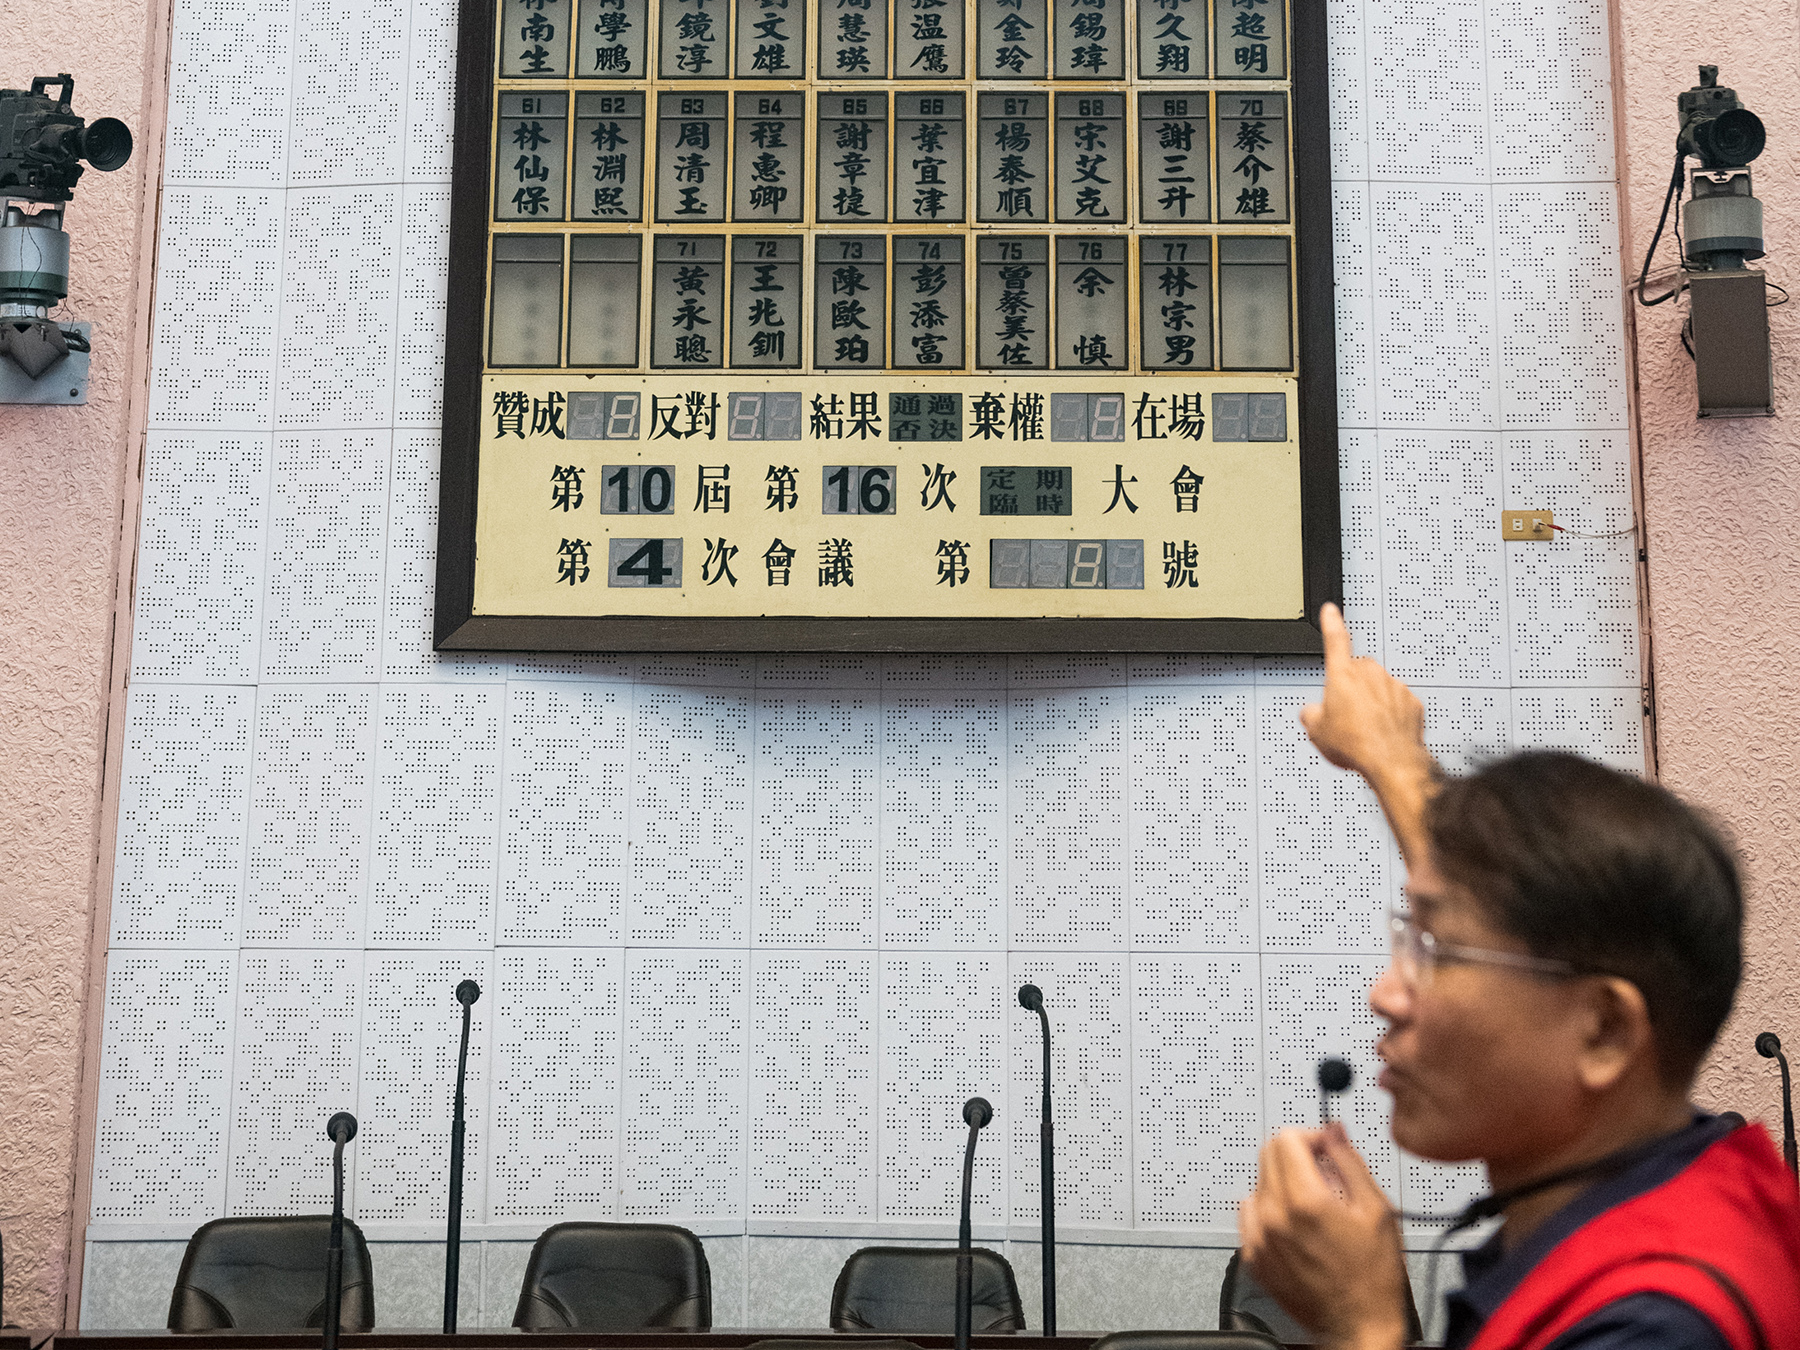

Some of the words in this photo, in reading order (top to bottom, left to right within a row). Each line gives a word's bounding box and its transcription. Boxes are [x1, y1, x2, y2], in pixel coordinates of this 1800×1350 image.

[522, 98, 541, 114] 61
[601, 97, 626, 114] 62
[681, 98, 704, 115] 63
[758, 98, 782, 115] 64
[1004, 98, 1028, 116] 67
[1240, 100, 1263, 116] 70
[512, 121, 550, 215] 林仙保
[674, 121, 710, 214] 周清玉
[750, 121, 787, 214] 程惠卿
[833, 121, 871, 216] 謝章捷
[912, 121, 948, 219] 葉宜津
[994, 121, 1035, 217] 楊泰順
[1157, 121, 1195, 217] 謝三升
[1233, 121, 1275, 218] 蔡介雄
[677, 242, 696, 256] 71
[755, 241, 777, 258] 72
[840, 242, 863, 259] 73
[918, 242, 941, 260] 74
[1000, 242, 1022, 260] 75
[1078, 242, 1102, 261] 76
[1163, 243, 1188, 262] 77
[748, 265, 785, 361] 王兆釧
[832, 265, 870, 363] 陳歐珀
[910, 265, 948, 364] 彭添富
[996, 265, 1034, 364] 曾蔡美佐
[1160, 265, 1197, 365] 林宗男
[493, 391, 566, 440] 贊成
[648, 391, 721, 440] 反對
[810, 391, 881, 440] 結果
[892, 395, 956, 416] 通過
[893, 419, 958, 440] 否決
[969, 392, 1044, 441] 棄權
[1131, 392, 1205, 441] 在場
[987, 469, 1063, 491] 定期
[989, 494, 1064, 514] 臨時
